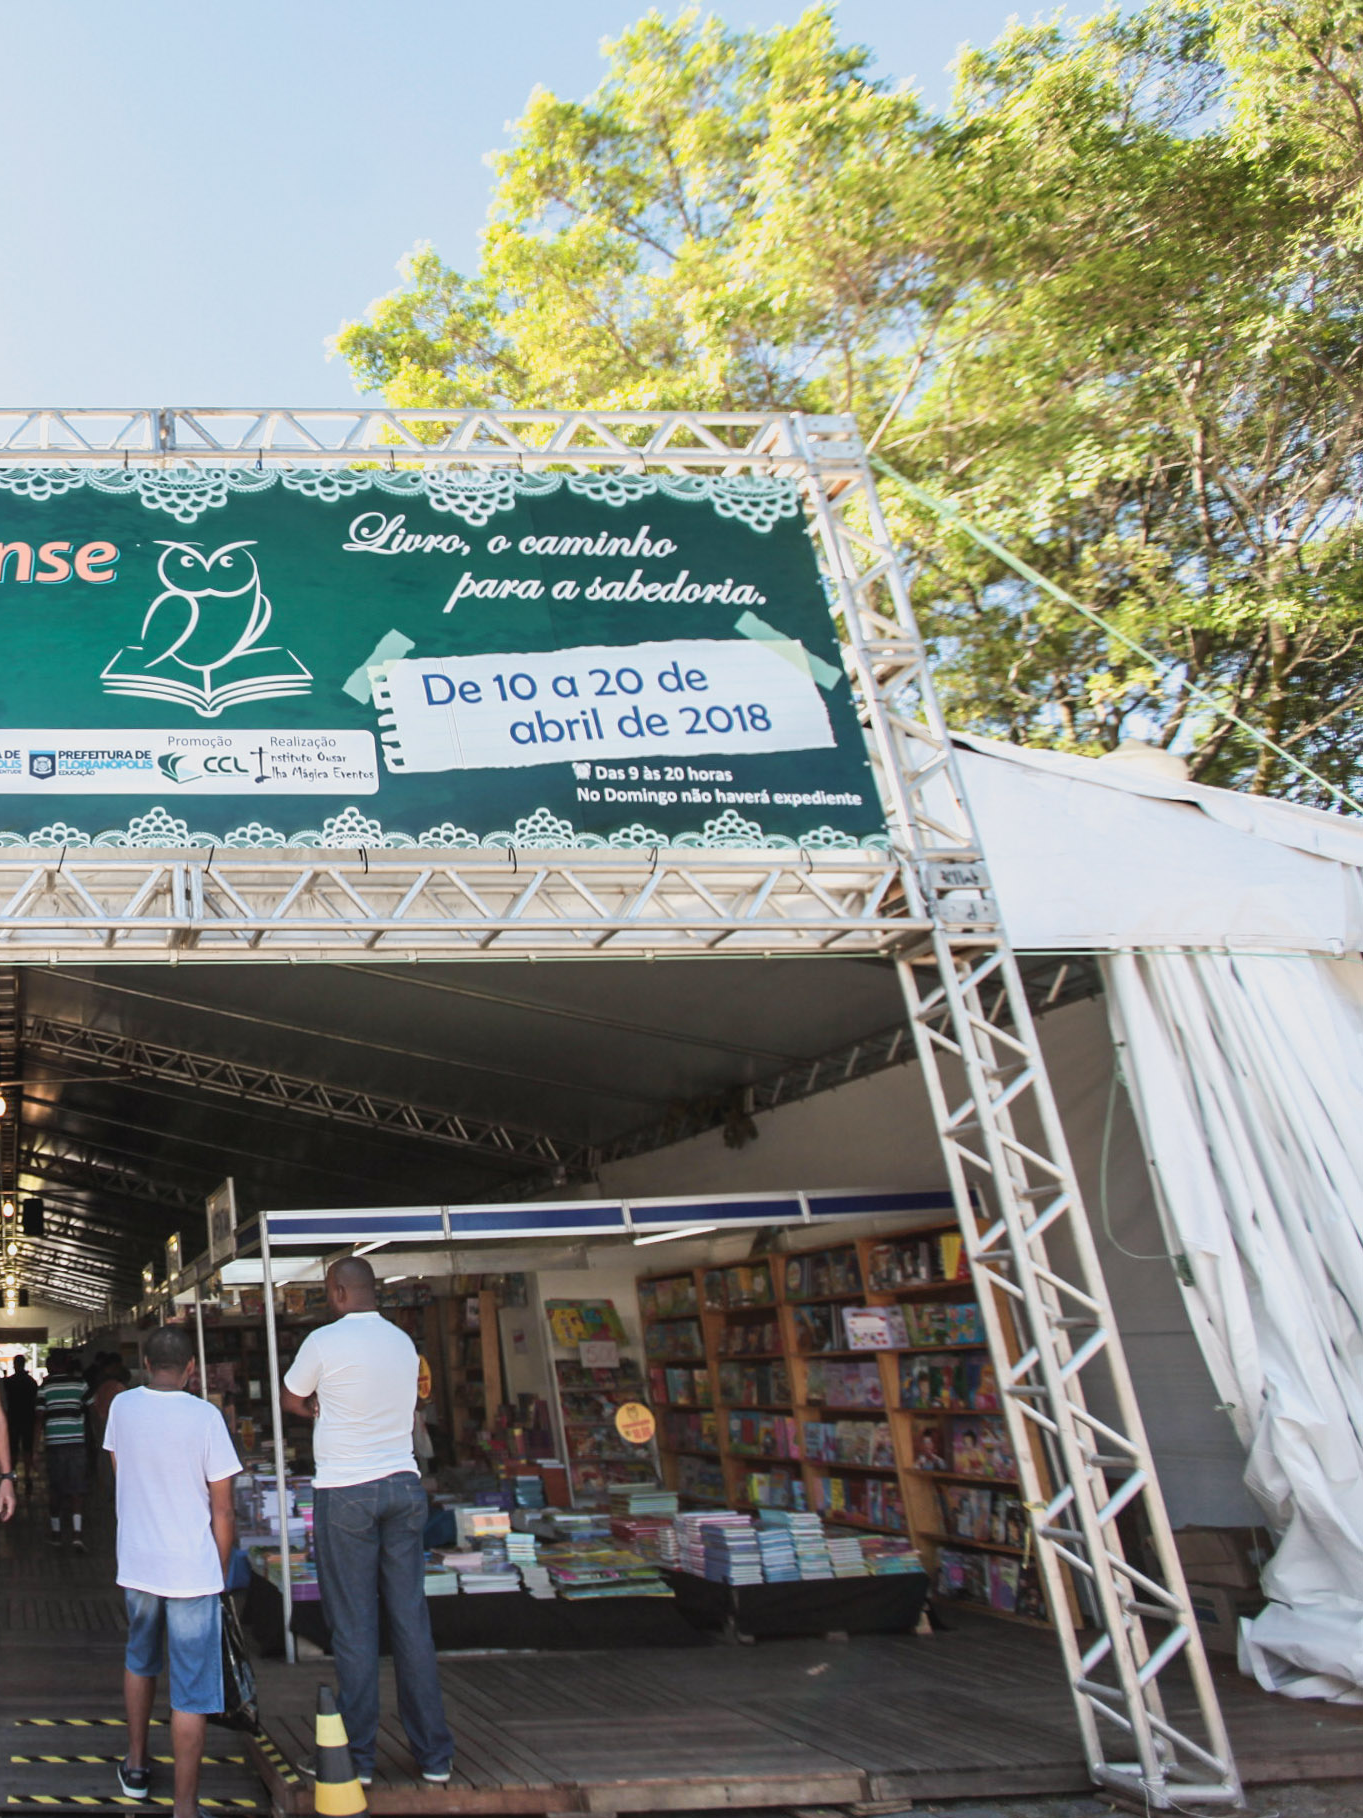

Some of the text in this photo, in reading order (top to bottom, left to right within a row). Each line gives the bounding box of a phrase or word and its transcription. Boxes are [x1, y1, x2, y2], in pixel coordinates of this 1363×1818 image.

[342, 511, 678, 558] Livro, o caminho
[443, 569, 767, 614] para a sabedoria.
[421, 660, 709, 706] De 10 a 20 de
[509, 703, 772, 745] abril de 2018
[167, 736, 233, 749] Promoção
[270, 736, 337, 749] Realização
[4, 750, 21, 759] DE
[58, 750, 152, 760] PREFEITURA DE
[317, 751, 347, 762] Ousar
[203, 756, 250, 773] CCL
[292, 766, 329, 782] Mágica
[333, 767, 375, 780] Eventos
[595, 764, 733, 783] Das 9 às 20 horas
[576, 786, 863, 808] No Domingo não haverá expediente
